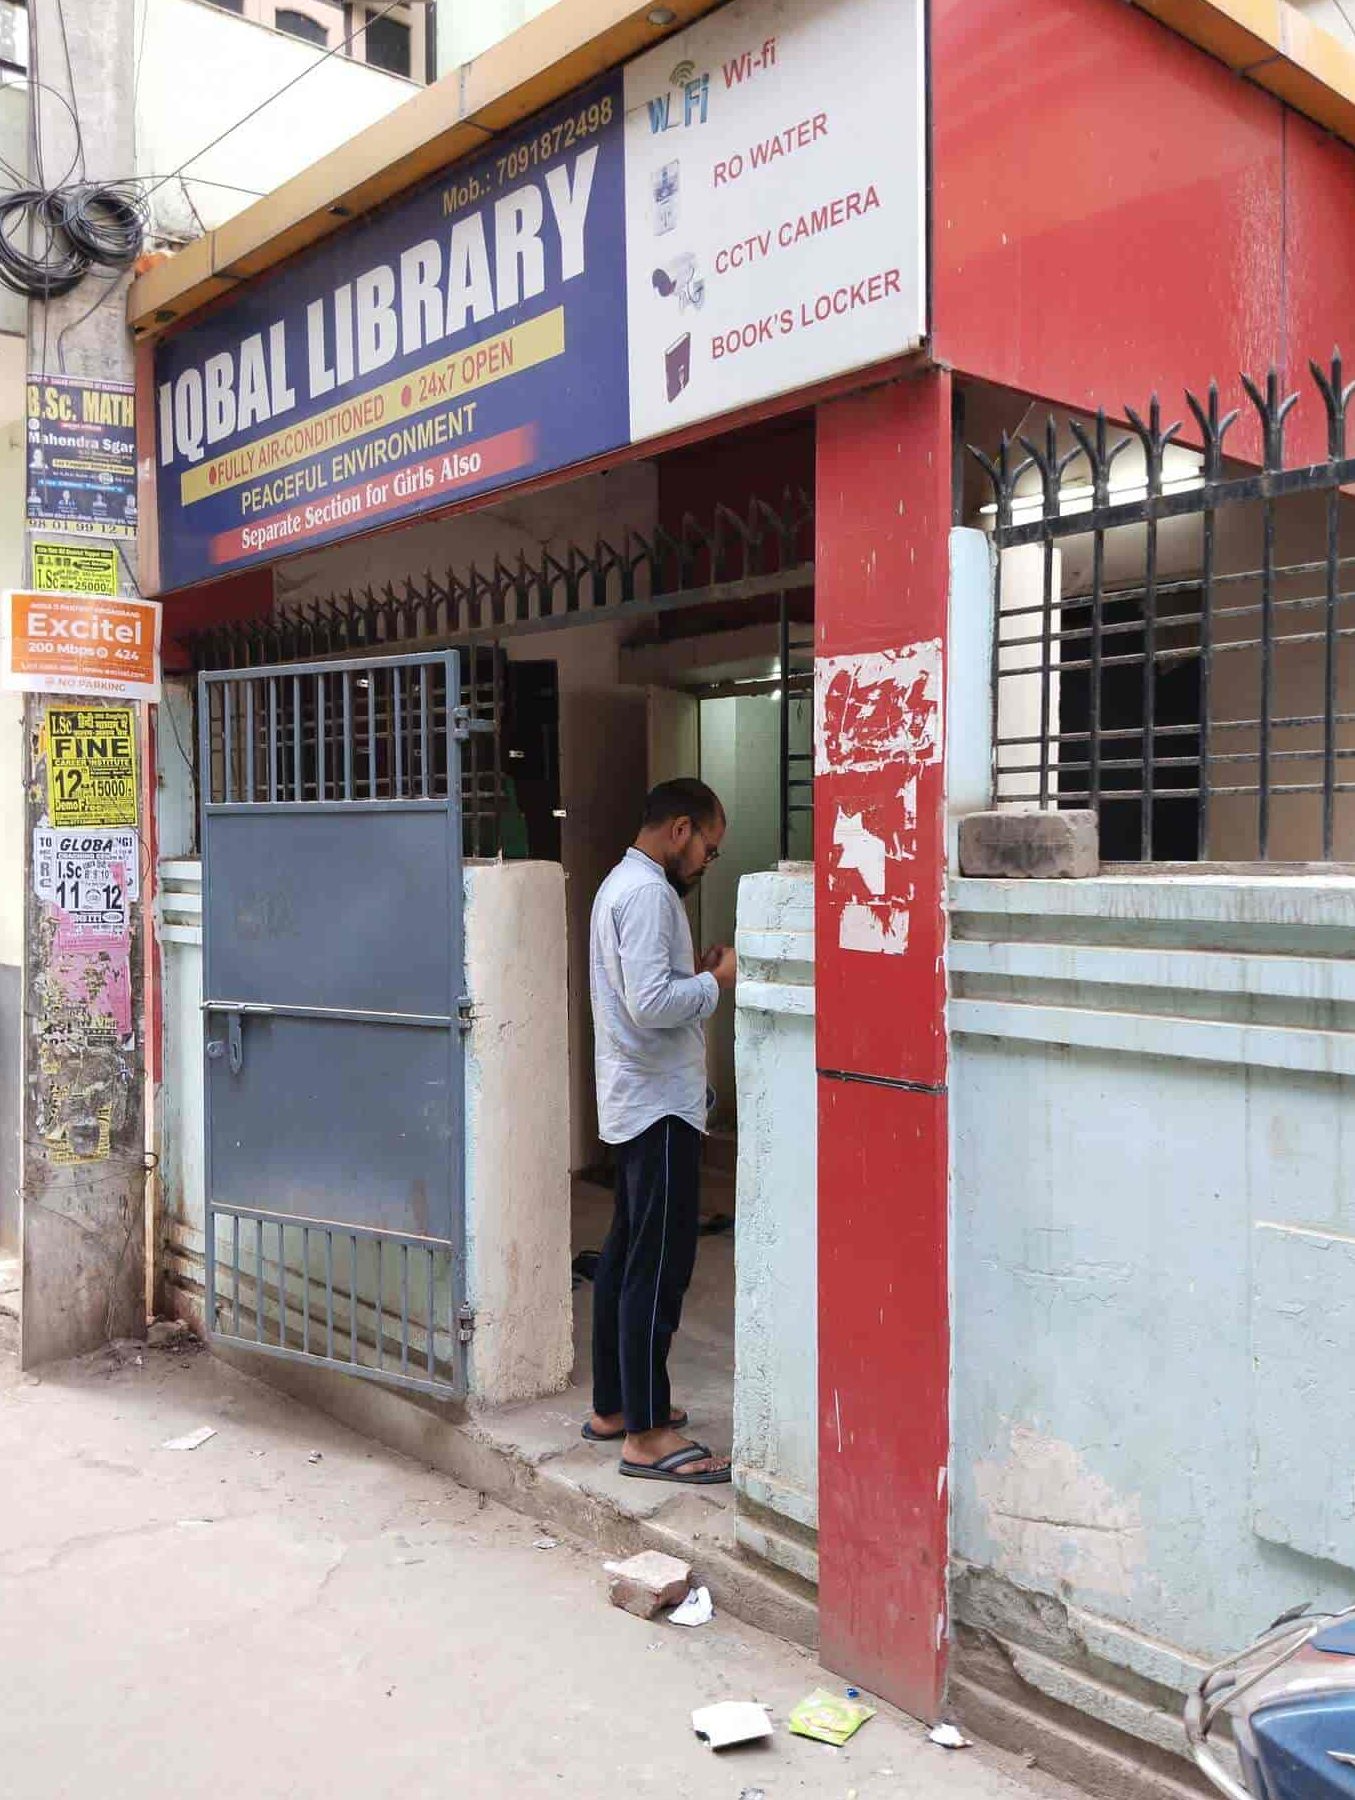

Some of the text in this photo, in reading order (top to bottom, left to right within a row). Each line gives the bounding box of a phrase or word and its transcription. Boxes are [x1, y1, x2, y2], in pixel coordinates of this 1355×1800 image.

[722, 38, 777, 88] Wi-fi
[443, 96, 614, 216] Mob.: 7091872498
[712, 112, 829, 188] RO WATER
[715, 185, 880, 275] CCTV CAMERA
[159, 144, 598, 467] IQBAL LIBRARY
[711, 268, 901, 360] BOOK'S LOCKER
[82, 389, 134, 427] MATH
[218, 338, 514, 482] FULLY AIR-CONDITIONED 24x7 OPEN
[242, 402, 477, 516] PEACEFUL ENVIRONMENT
[242, 451, 481, 550] Separate Section for Girls Also
[27, 612, 142, 645] Excitel
[29, 642, 54, 653] 200
[57, 643, 95, 657] Mbps
[55, 738, 129, 758] FINE
[57, 861, 82, 879] I.Sc
